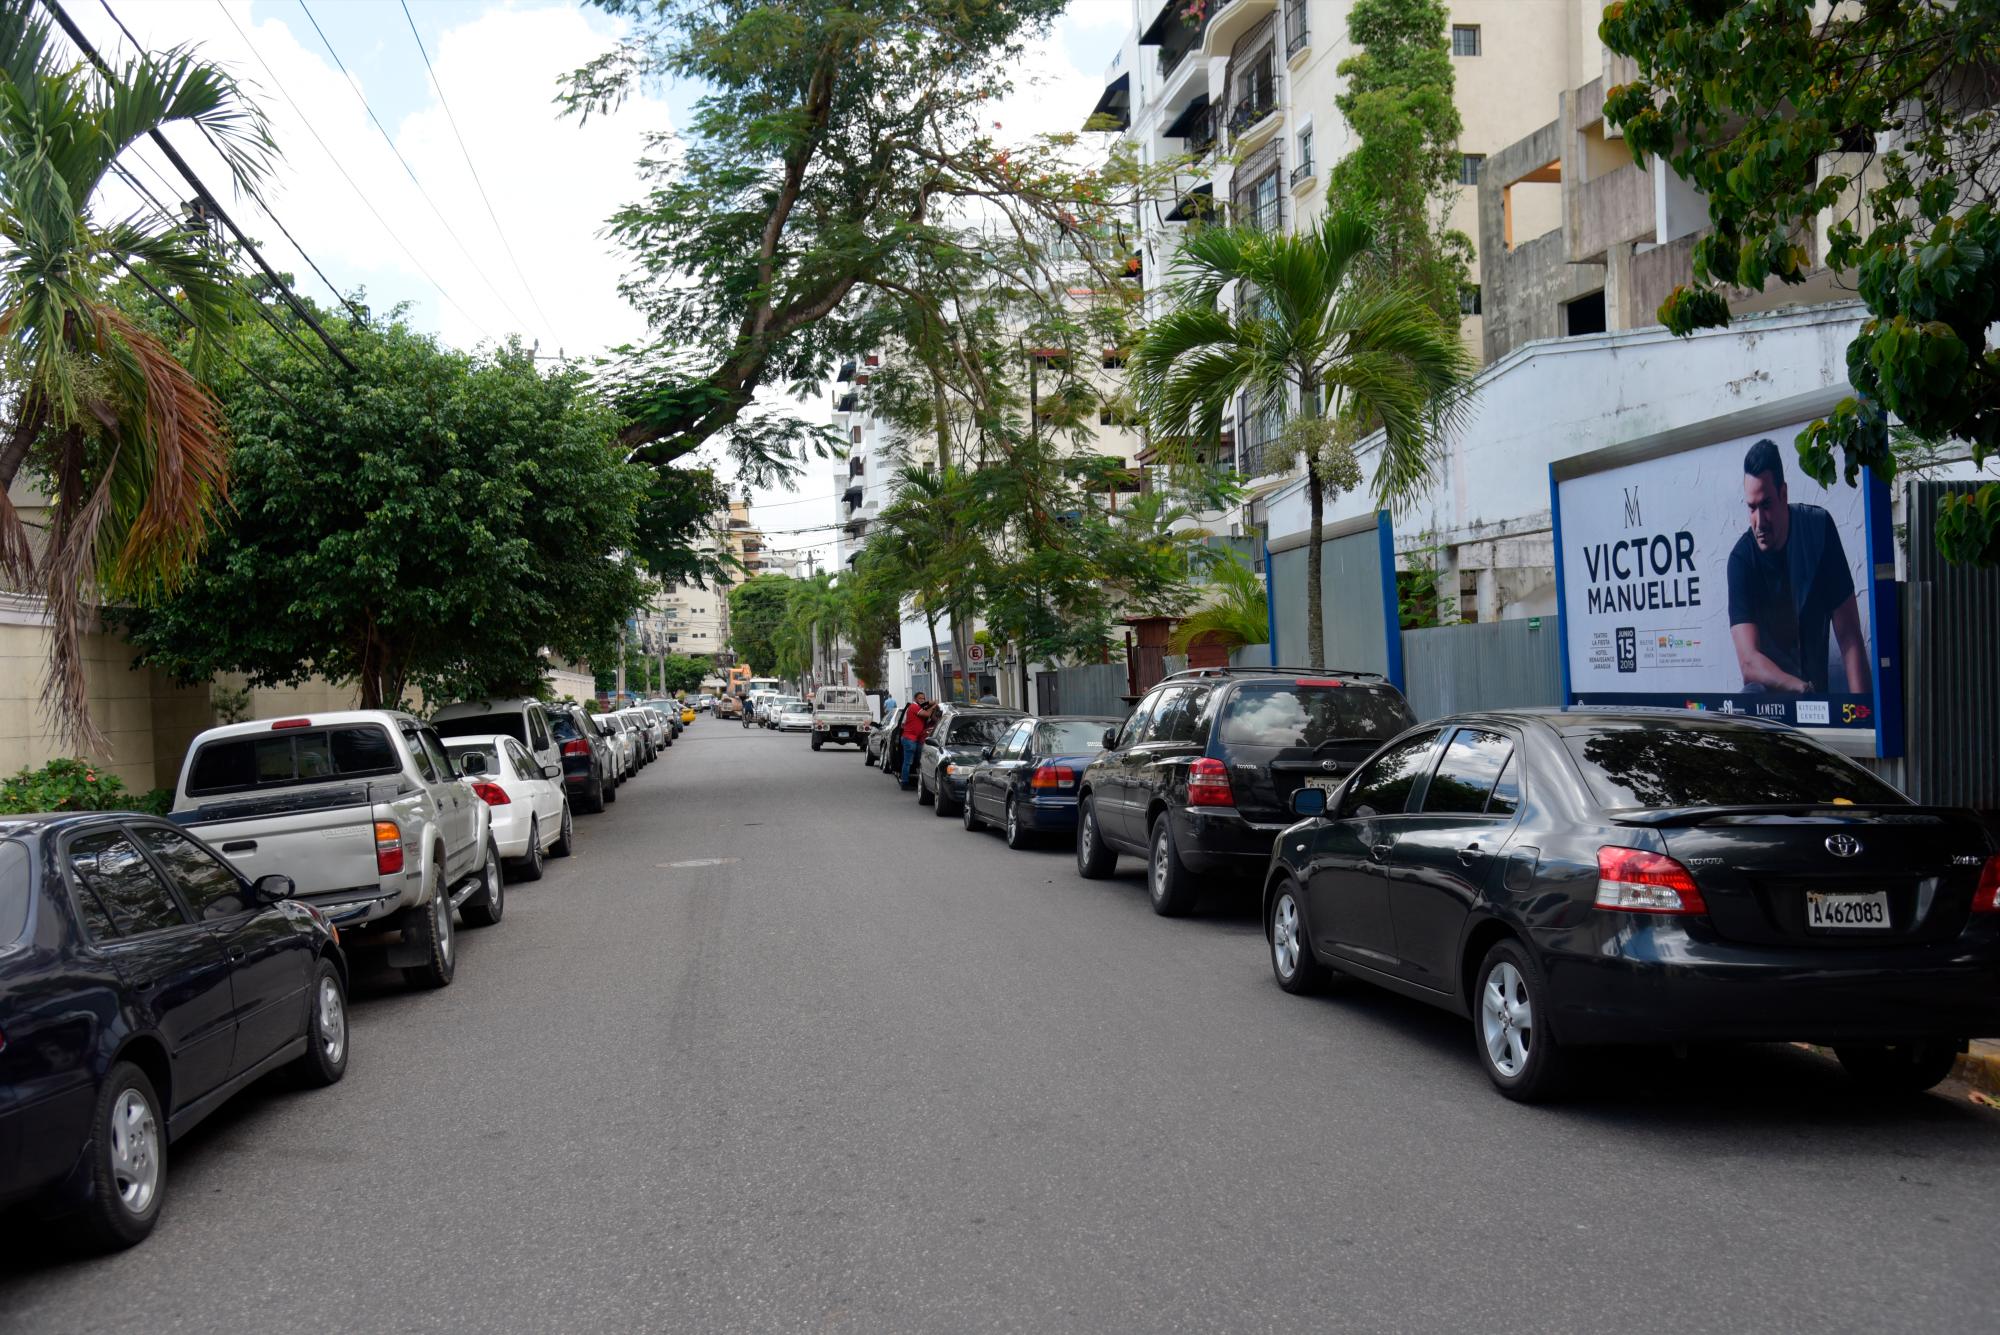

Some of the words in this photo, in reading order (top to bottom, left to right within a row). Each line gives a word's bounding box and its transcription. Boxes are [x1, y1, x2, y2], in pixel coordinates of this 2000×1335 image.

[1583, 531, 1697, 583] VICTOR
[1588, 577, 1701, 614] MANUELLE
[1618, 639, 1634, 659] 15
[1620, 660, 1634, 669] 2019
[1688, 857, 1725, 865] TOYOTA
[1813, 897, 1883, 923] A462083
